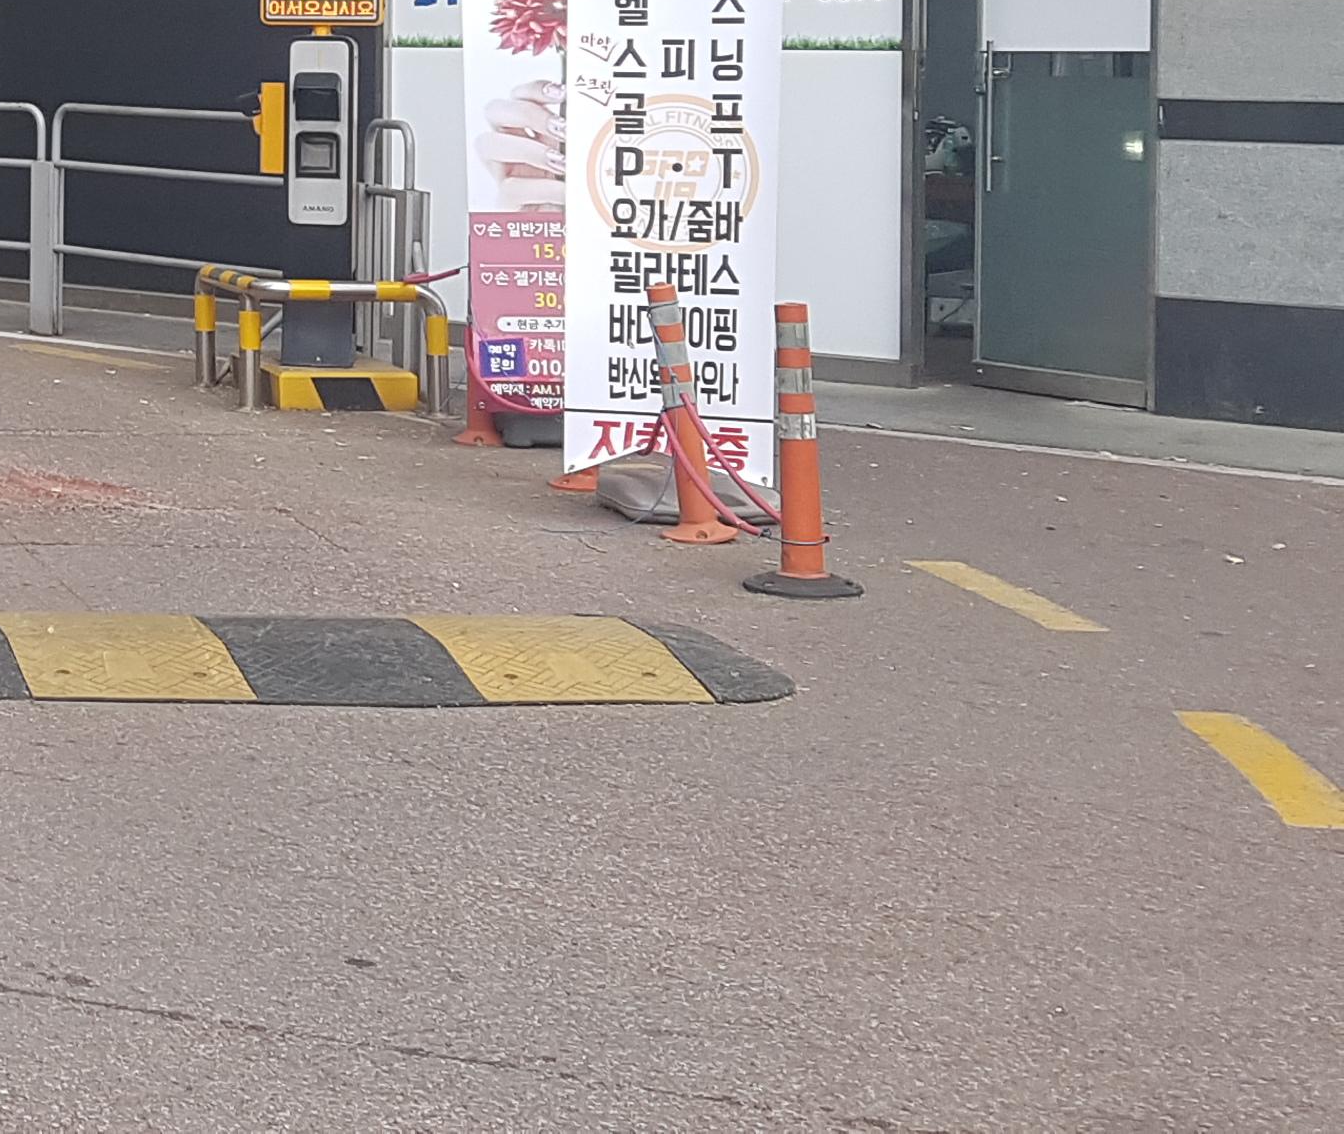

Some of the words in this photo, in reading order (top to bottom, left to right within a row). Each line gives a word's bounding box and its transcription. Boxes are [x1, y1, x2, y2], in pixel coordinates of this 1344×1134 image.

[611, 198, 743, 243] 요가/줌바
[610, 251, 740, 296] 필라테스
[609, 304, 737, 352] 바디이핑
